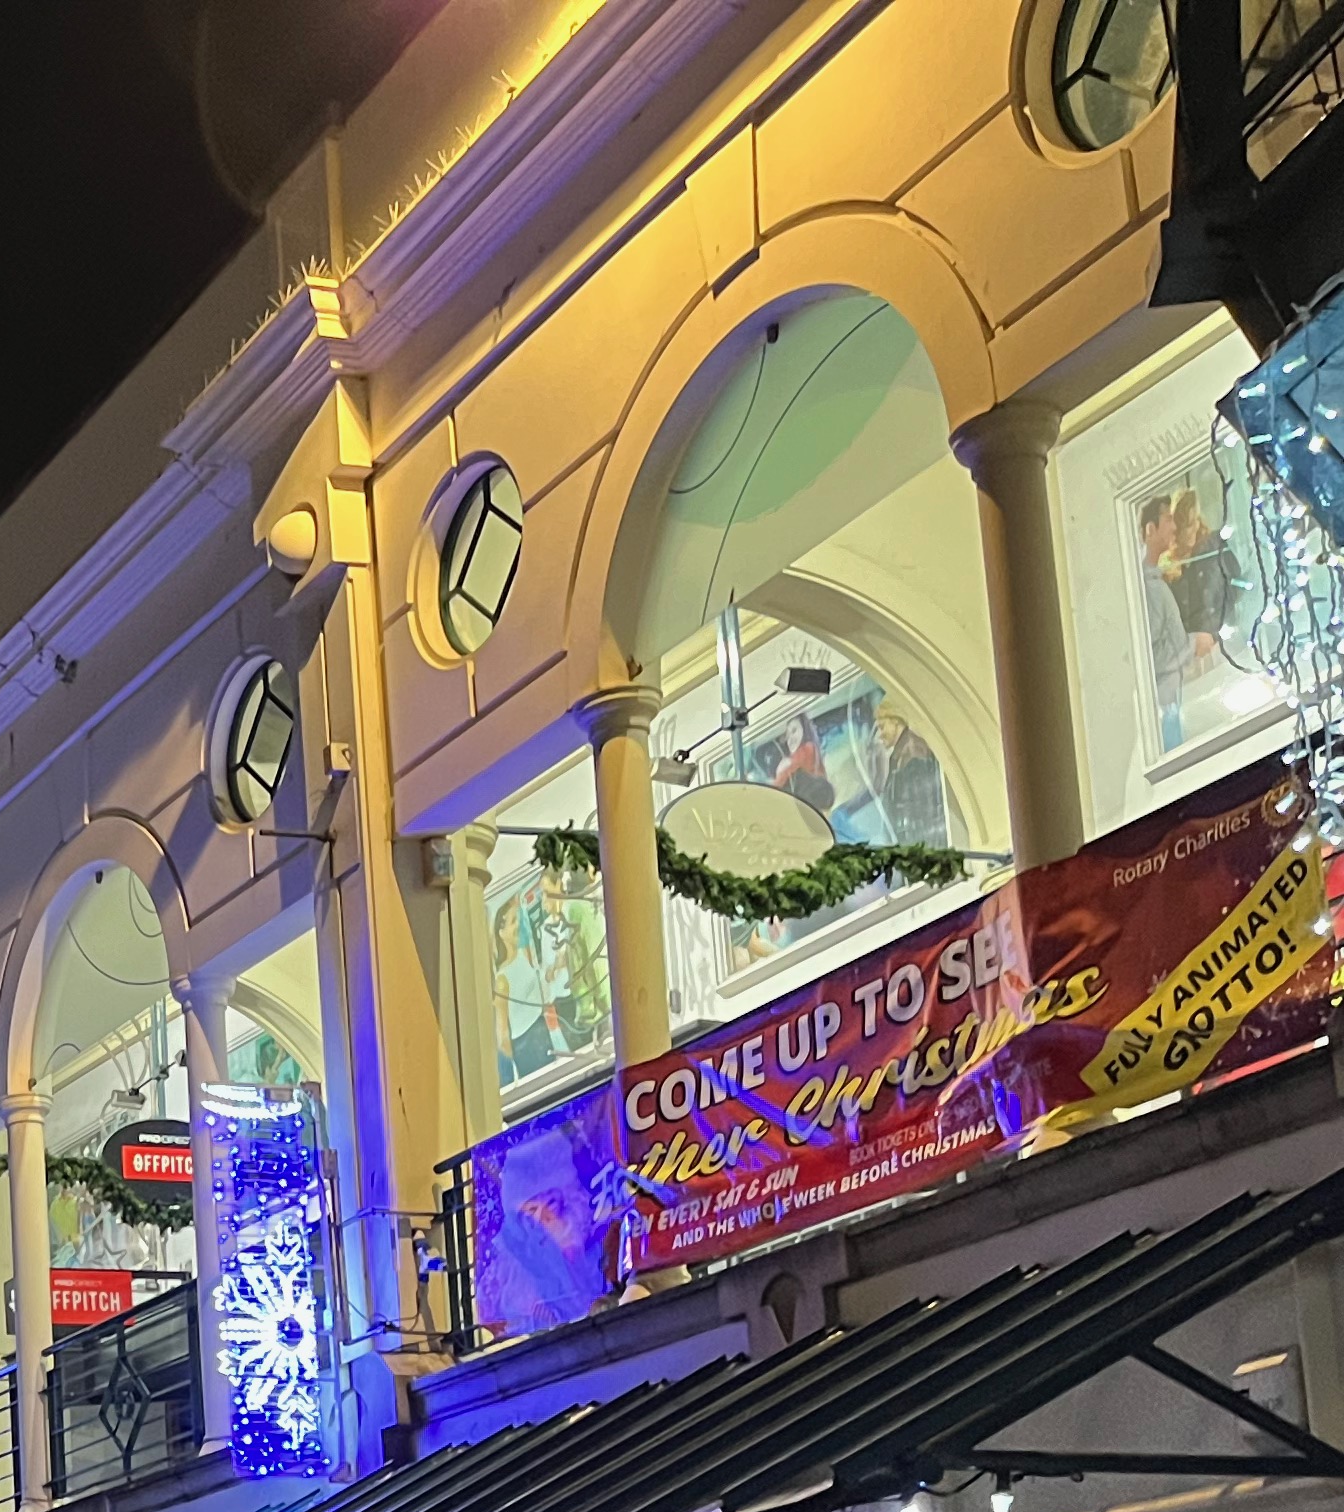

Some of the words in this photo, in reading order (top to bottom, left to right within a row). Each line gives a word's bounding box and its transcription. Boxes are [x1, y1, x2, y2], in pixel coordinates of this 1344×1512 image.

[1112, 848, 1169, 888] Rotary
[1174, 810, 1251, 860] Charities
[625, 1033, 766, 1132] COME
[776, 1001, 841, 1074] UP
[854, 964, 925, 1038] TO
[939, 909, 1017, 1001] SEE
[1103, 1004, 1163, 1085] FULLY
[1172, 857, 1308, 1011] ANIMATED
[1163, 928, 1298, 1071] GROTTO!
[590, 1116, 768, 1222] Father
[784, 966, 1109, 1146] Christmas
[133, 1153, 193, 1175] OFFPITC
[658, 1195, 712, 1231] EVERY
[713, 1184, 746, 1213] SAT
[761, 1164, 799, 1196] SUN
[672, 1227, 705, 1250] AND
[707, 1216, 736, 1239] THE
[794, 1181, 837, 1209] WEEK
[840, 1158, 899, 1194] BEFORE
[901, 1116, 996, 1168] CHRISTMAS
[52, 1290, 122, 1312] FFPITCH
